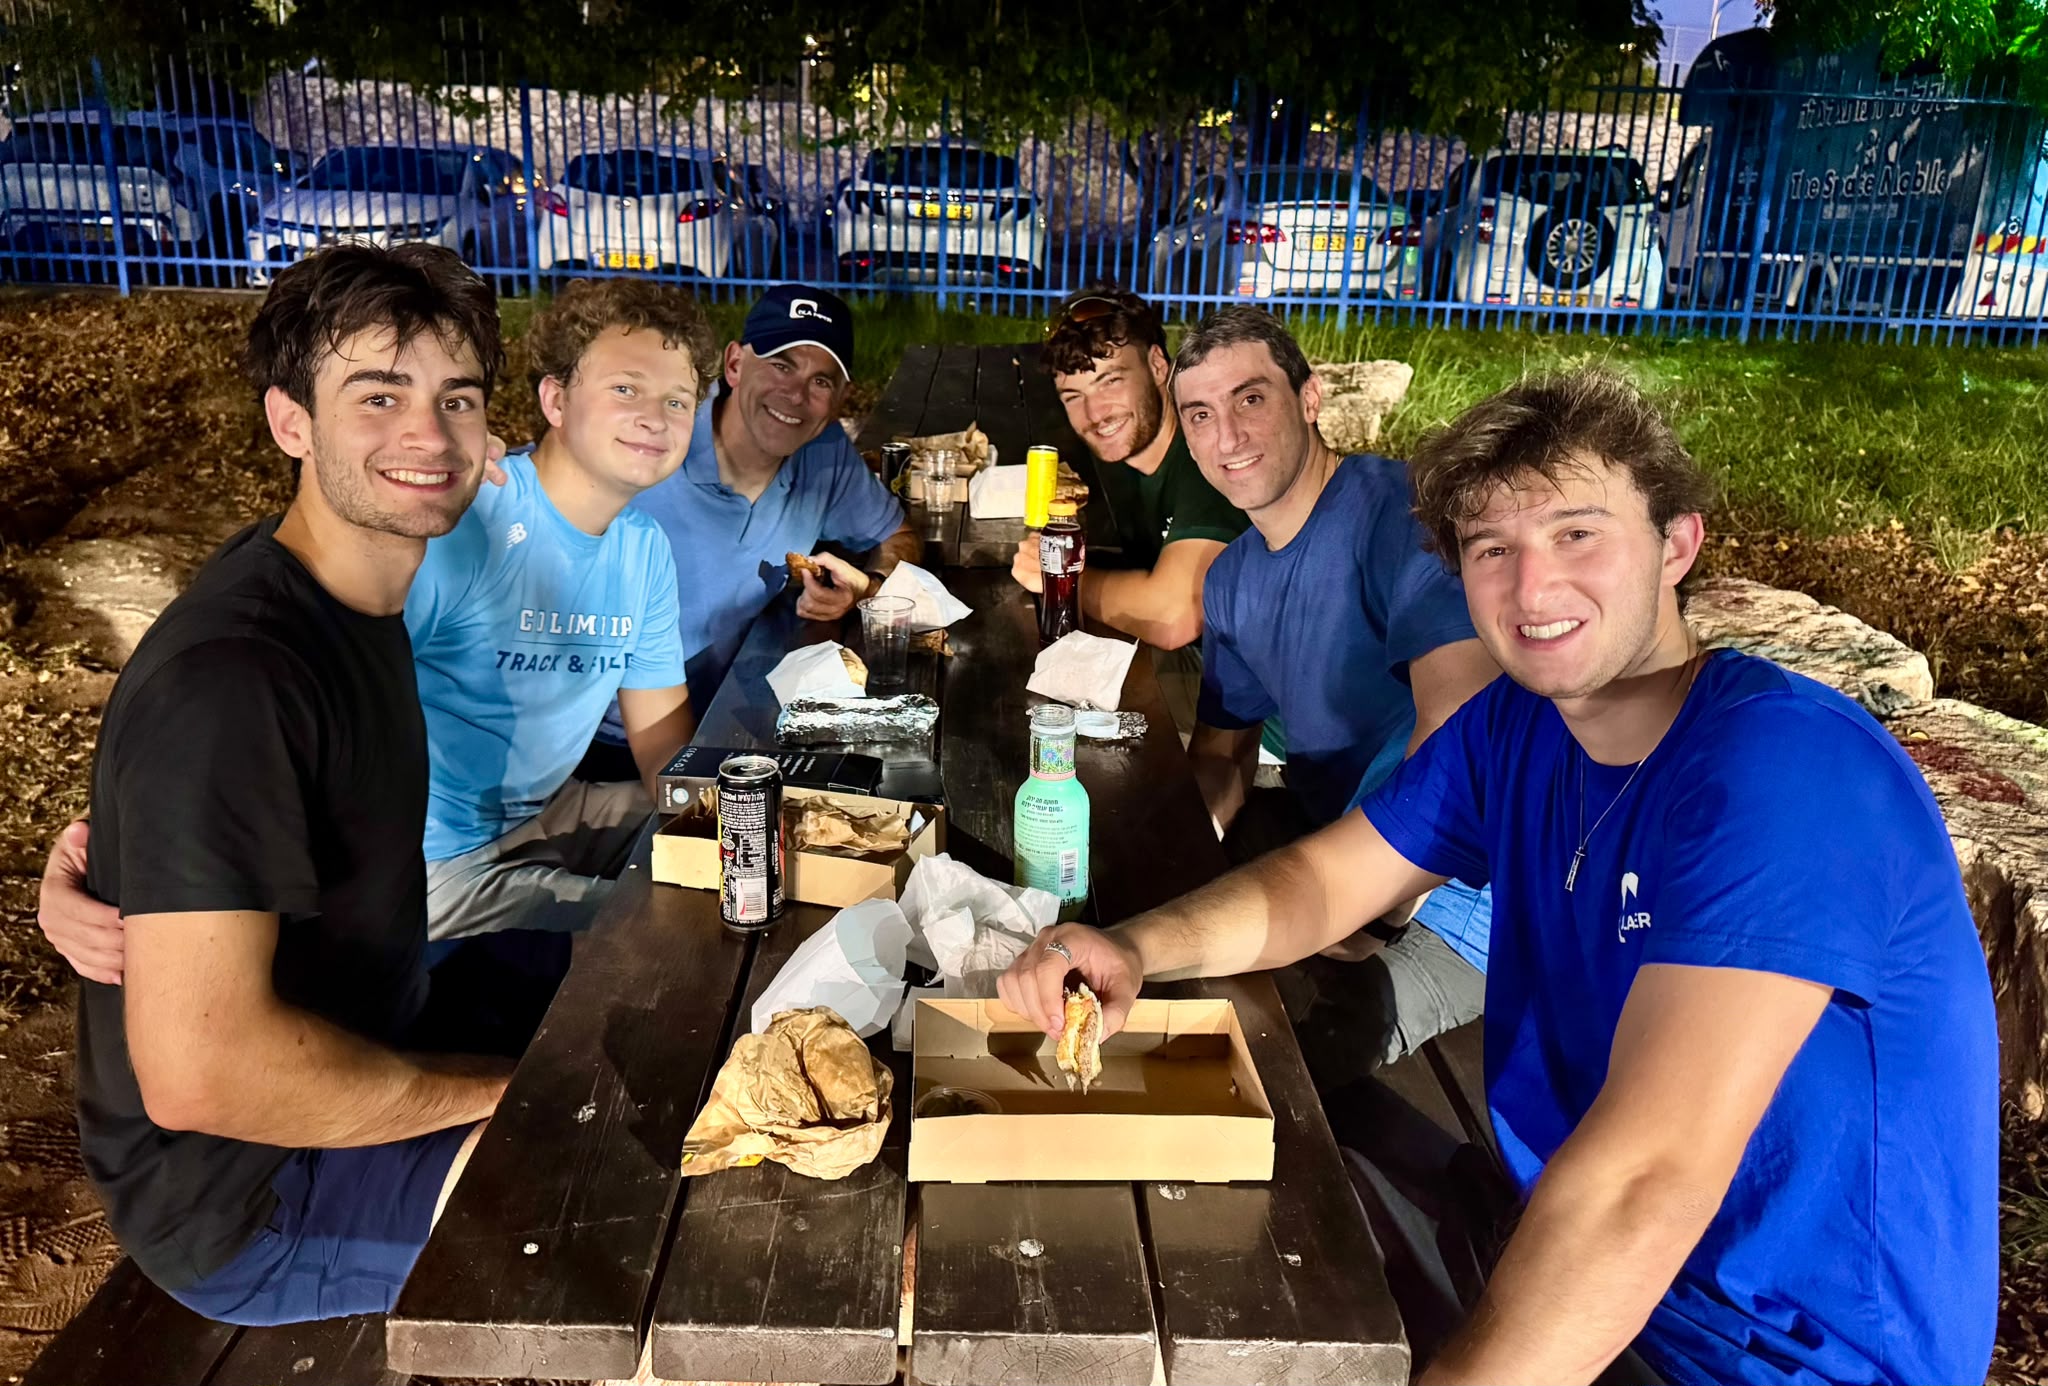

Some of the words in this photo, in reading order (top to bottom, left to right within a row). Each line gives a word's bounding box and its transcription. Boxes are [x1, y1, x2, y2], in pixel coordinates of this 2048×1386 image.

[1791, 169, 1820, 200] Te
[519, 608, 633, 637] CLMIA
[495, 650, 561, 672] TRACK
[567, 654, 585, 673] &
